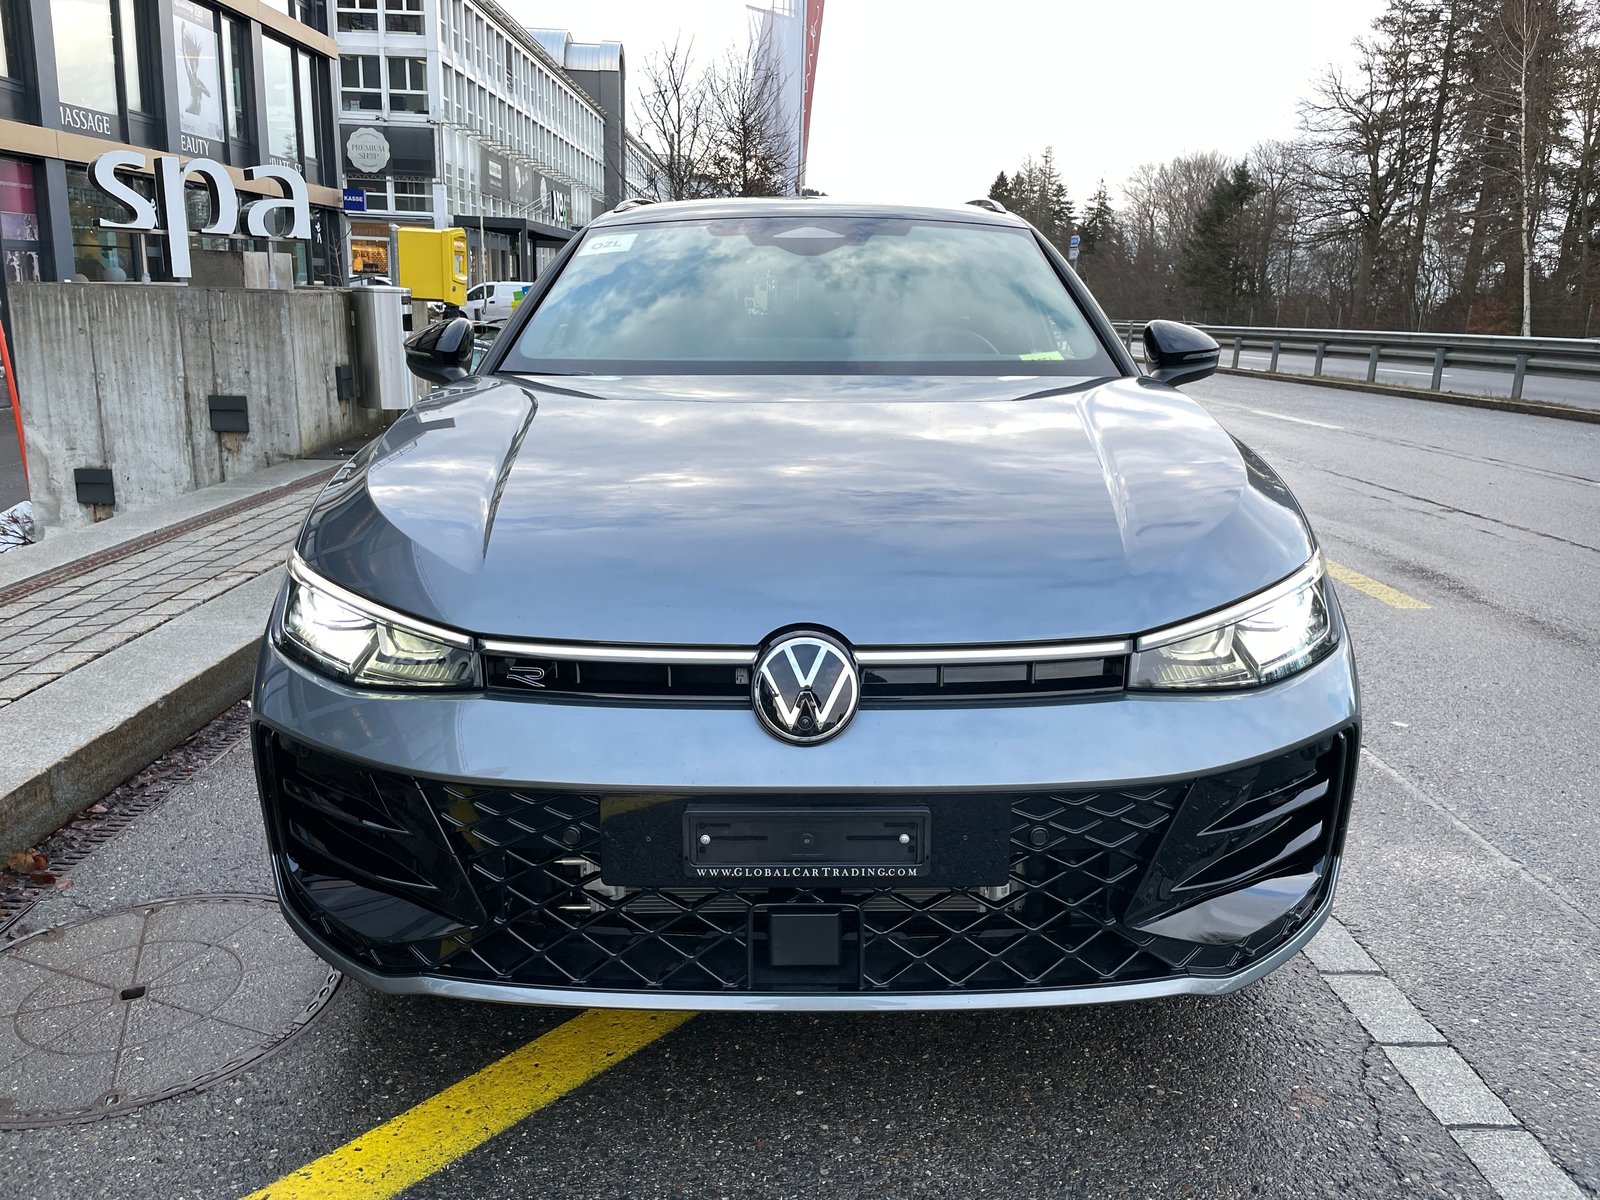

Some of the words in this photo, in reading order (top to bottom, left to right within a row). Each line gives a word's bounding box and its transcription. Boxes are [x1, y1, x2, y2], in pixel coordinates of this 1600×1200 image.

[351, 144, 386, 152] PREMIUM
[343, 195, 364, 203] KASSE
[88, 149, 312, 279] spa
[696, 867, 919, 878] WWW.GLOBALCARTRADING.COM
